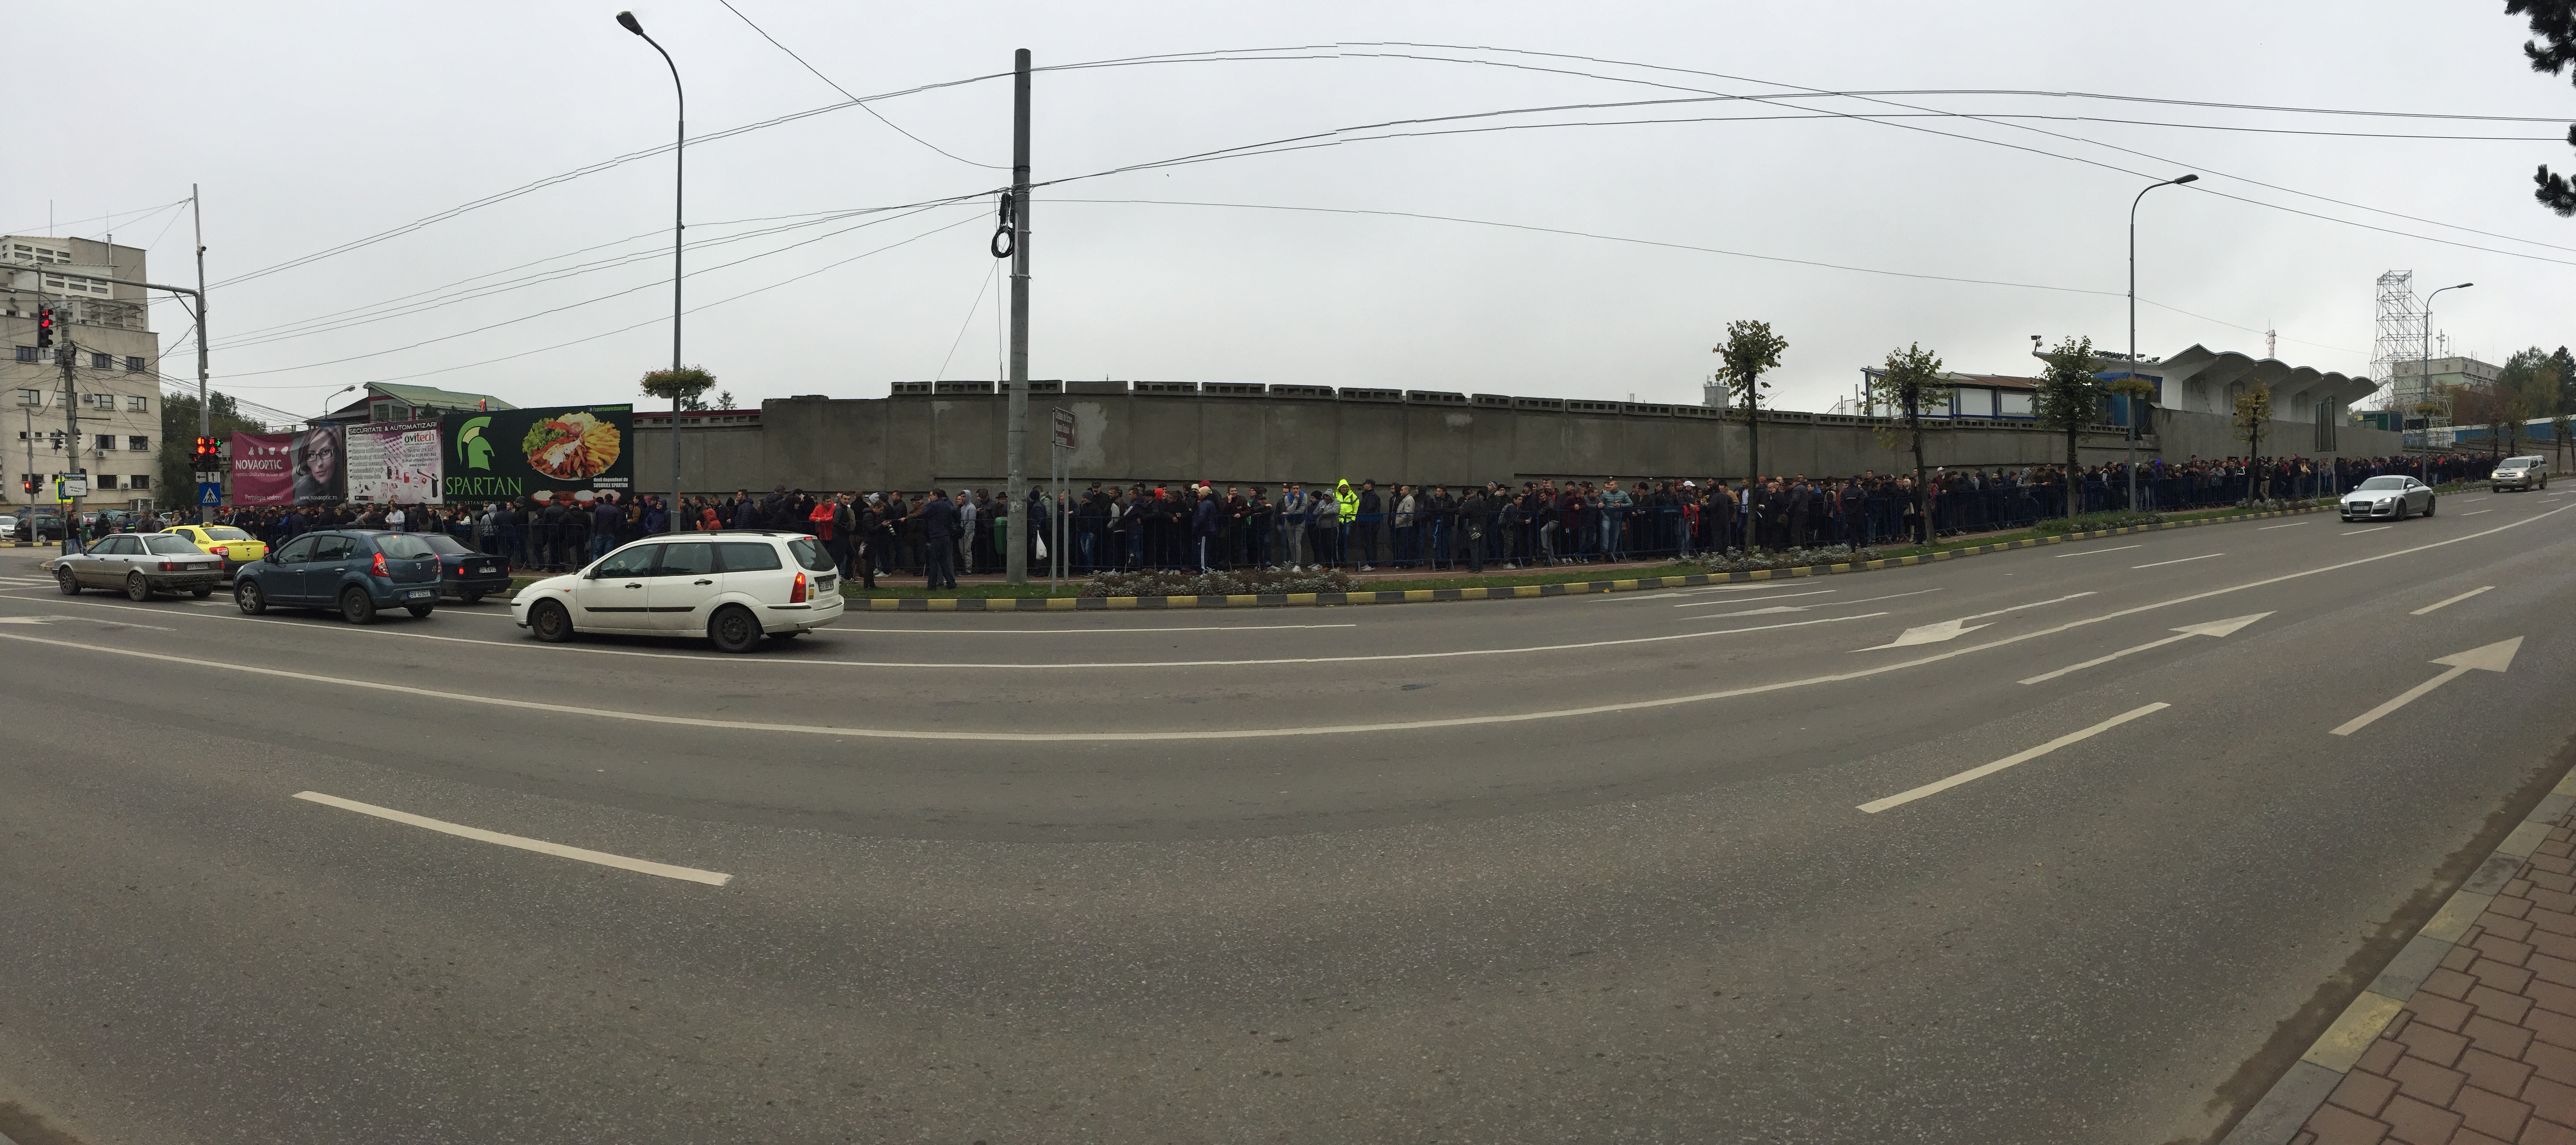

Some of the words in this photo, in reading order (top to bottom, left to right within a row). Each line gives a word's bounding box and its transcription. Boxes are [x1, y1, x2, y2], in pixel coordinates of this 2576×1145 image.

[390, 422, 437, 431] AUTOMATIZARI
[405, 431, 434, 443] ovitech
[235, 459, 283, 470] NOVAOPTIC
[446, 476, 522, 495] SPARTAN
